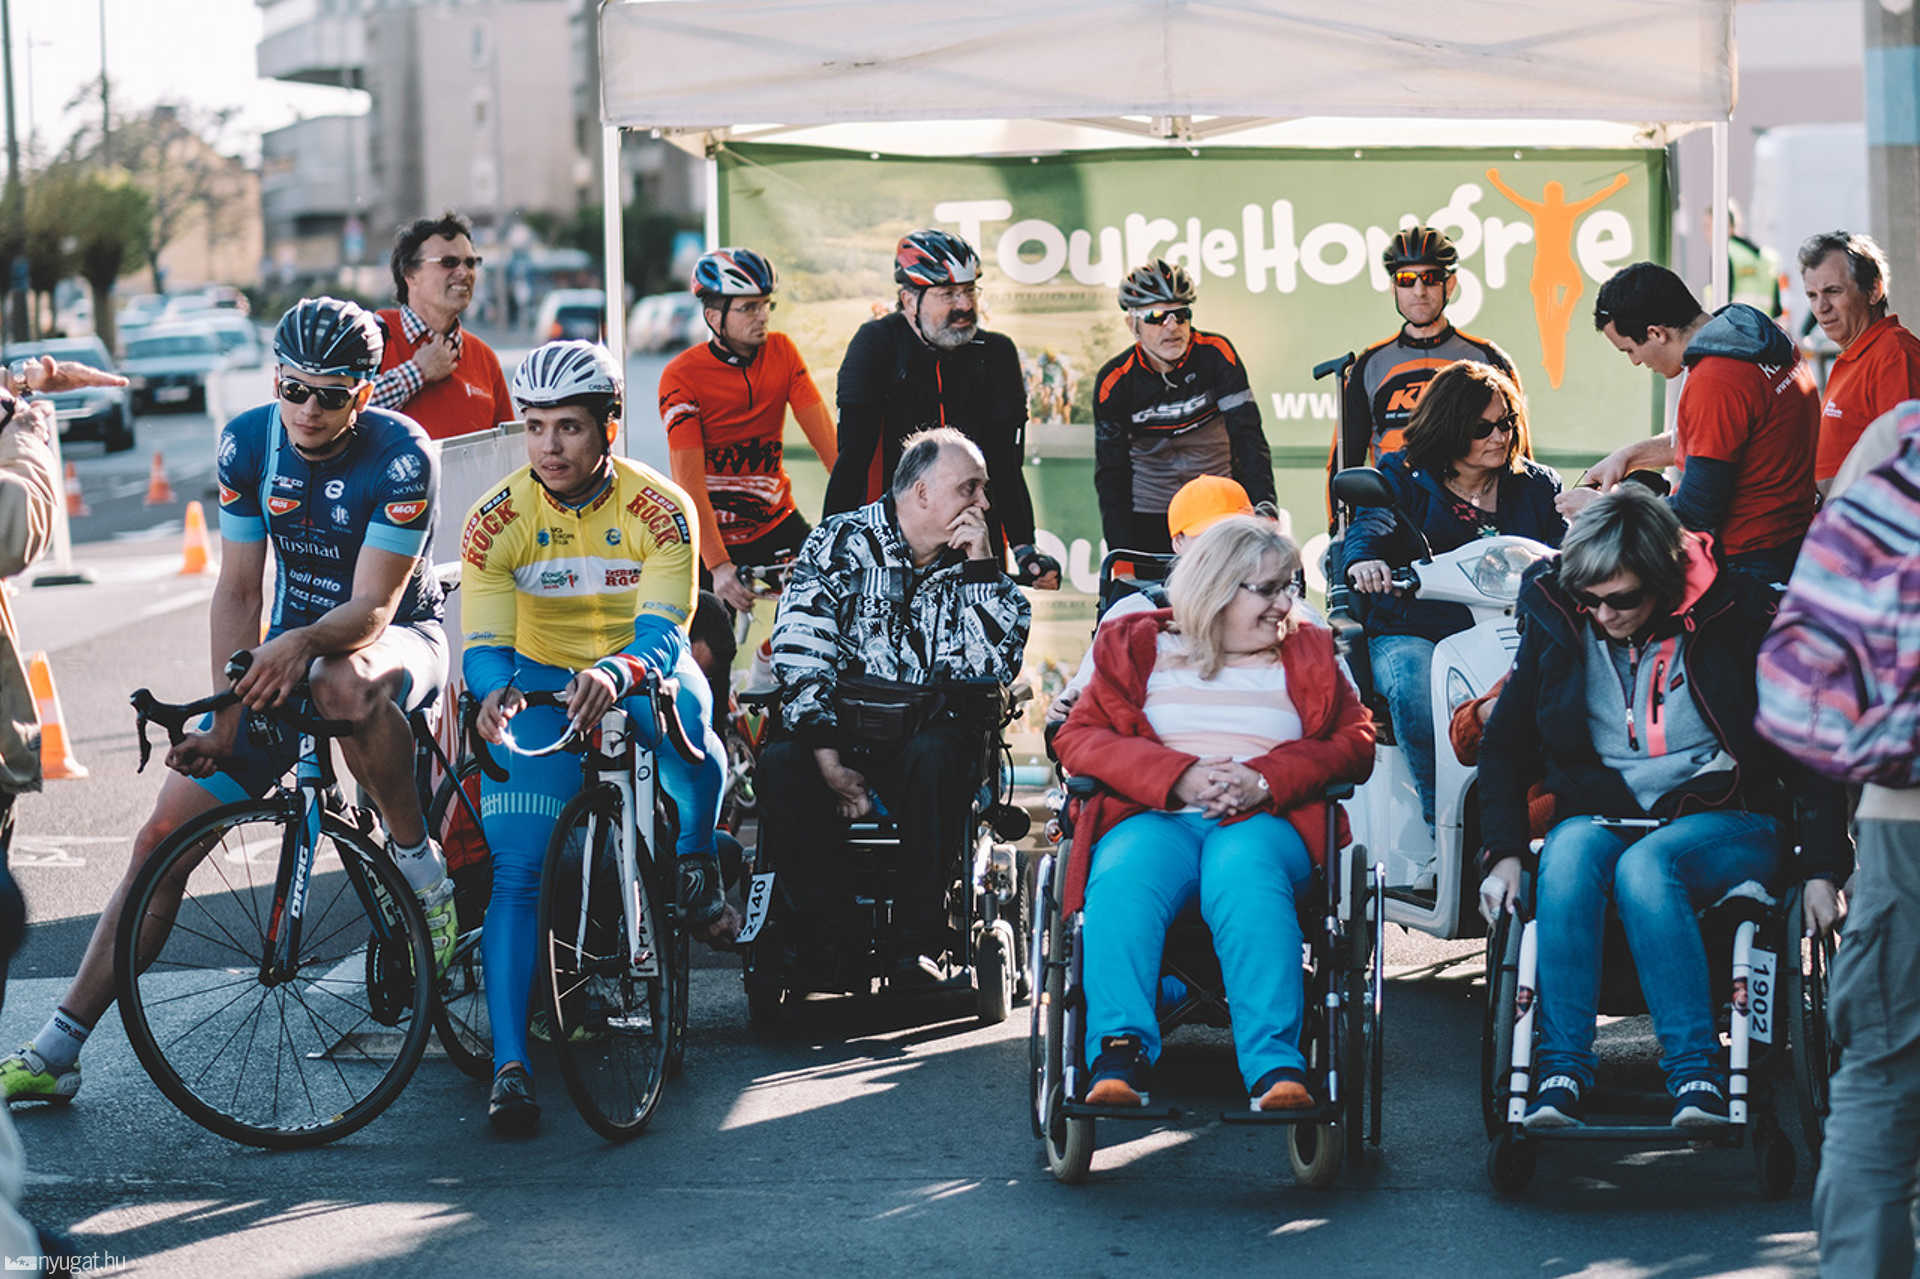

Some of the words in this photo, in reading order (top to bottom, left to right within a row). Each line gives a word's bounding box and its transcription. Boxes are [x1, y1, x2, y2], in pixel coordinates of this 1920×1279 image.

[1242, 168, 1634, 328] Hongre
[1272, 393, 1338, 419] ww
[1386, 381, 1431, 411] KT
[467, 499, 519, 571] ROCK
[627, 493, 680, 548] ROCK
[741, 880, 766, 937] 2140
[1752, 963, 1771, 1034] 1902
